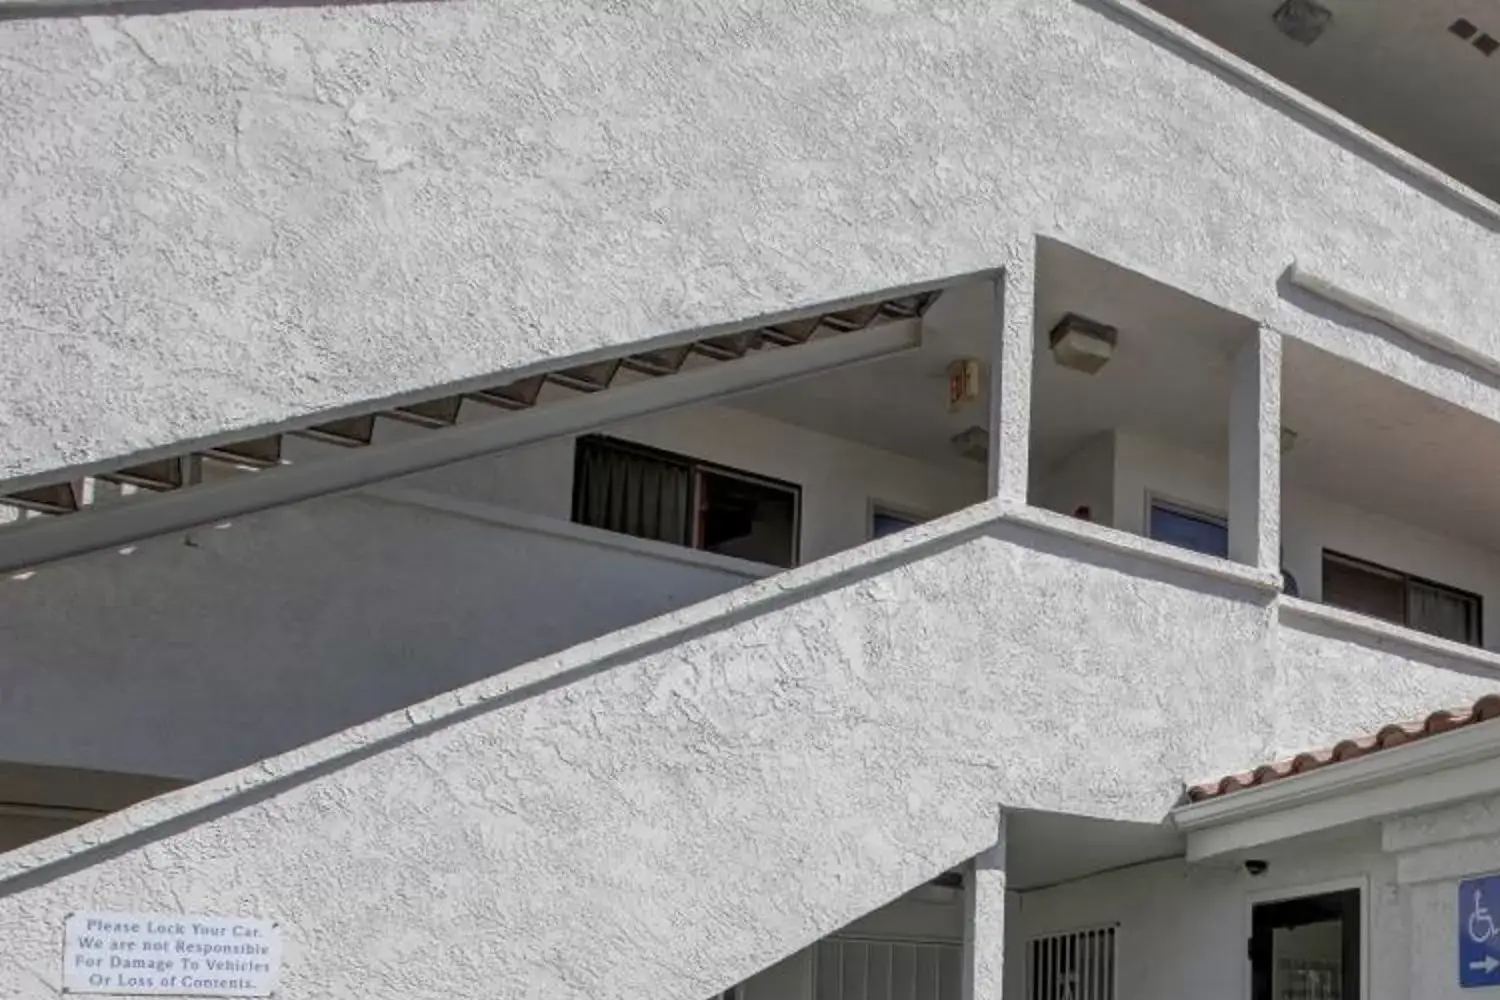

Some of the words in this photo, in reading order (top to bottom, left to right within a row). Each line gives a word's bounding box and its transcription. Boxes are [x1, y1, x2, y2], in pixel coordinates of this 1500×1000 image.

[86, 919, 141, 934] Please
[146, 921, 186, 935] Lock
[192, 923, 226, 937] Your
[78, 935, 104, 950] We
[110, 940, 137, 951] are
[142, 940, 169, 953] not
[175, 940, 269, 956] Responsible
[75, 954, 104, 968] For
[110, 955, 174, 972] Damage
[180, 957, 199, 970] To
[206, 959, 270, 972] Vehicles
[88, 973, 112, 986] Or
[117, 973, 154, 987] Loss
[160, 975, 178, 987] of
